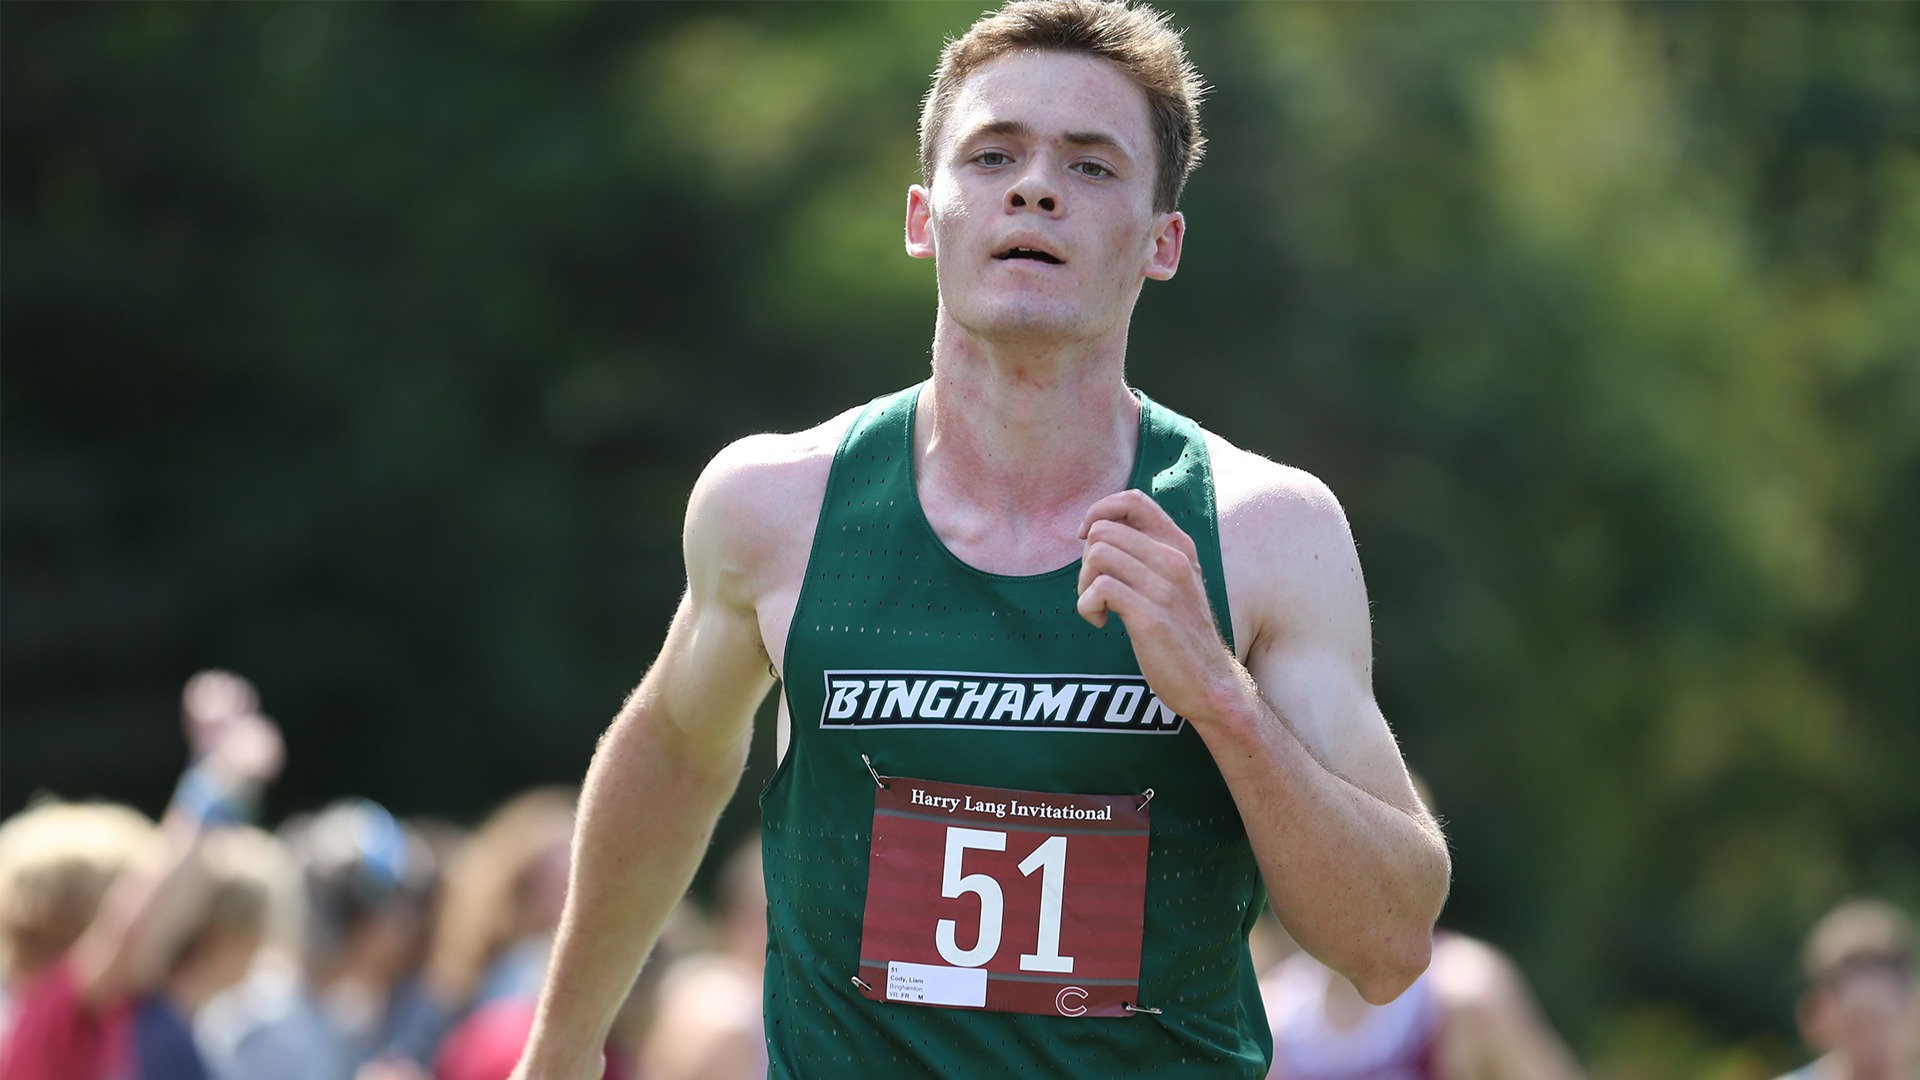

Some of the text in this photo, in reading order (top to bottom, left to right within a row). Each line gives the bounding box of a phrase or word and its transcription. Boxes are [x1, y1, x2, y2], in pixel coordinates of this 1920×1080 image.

[827, 679, 1177, 725] BINGHAMTON
[911, 789, 1112, 821] Harry Lang Invitational
[935, 826, 1075, 974] 51
[889, 983, 924, 992] Binghamton
[890, 975, 907, 983] Cody,
[1055, 986, 1089, 1018] C
